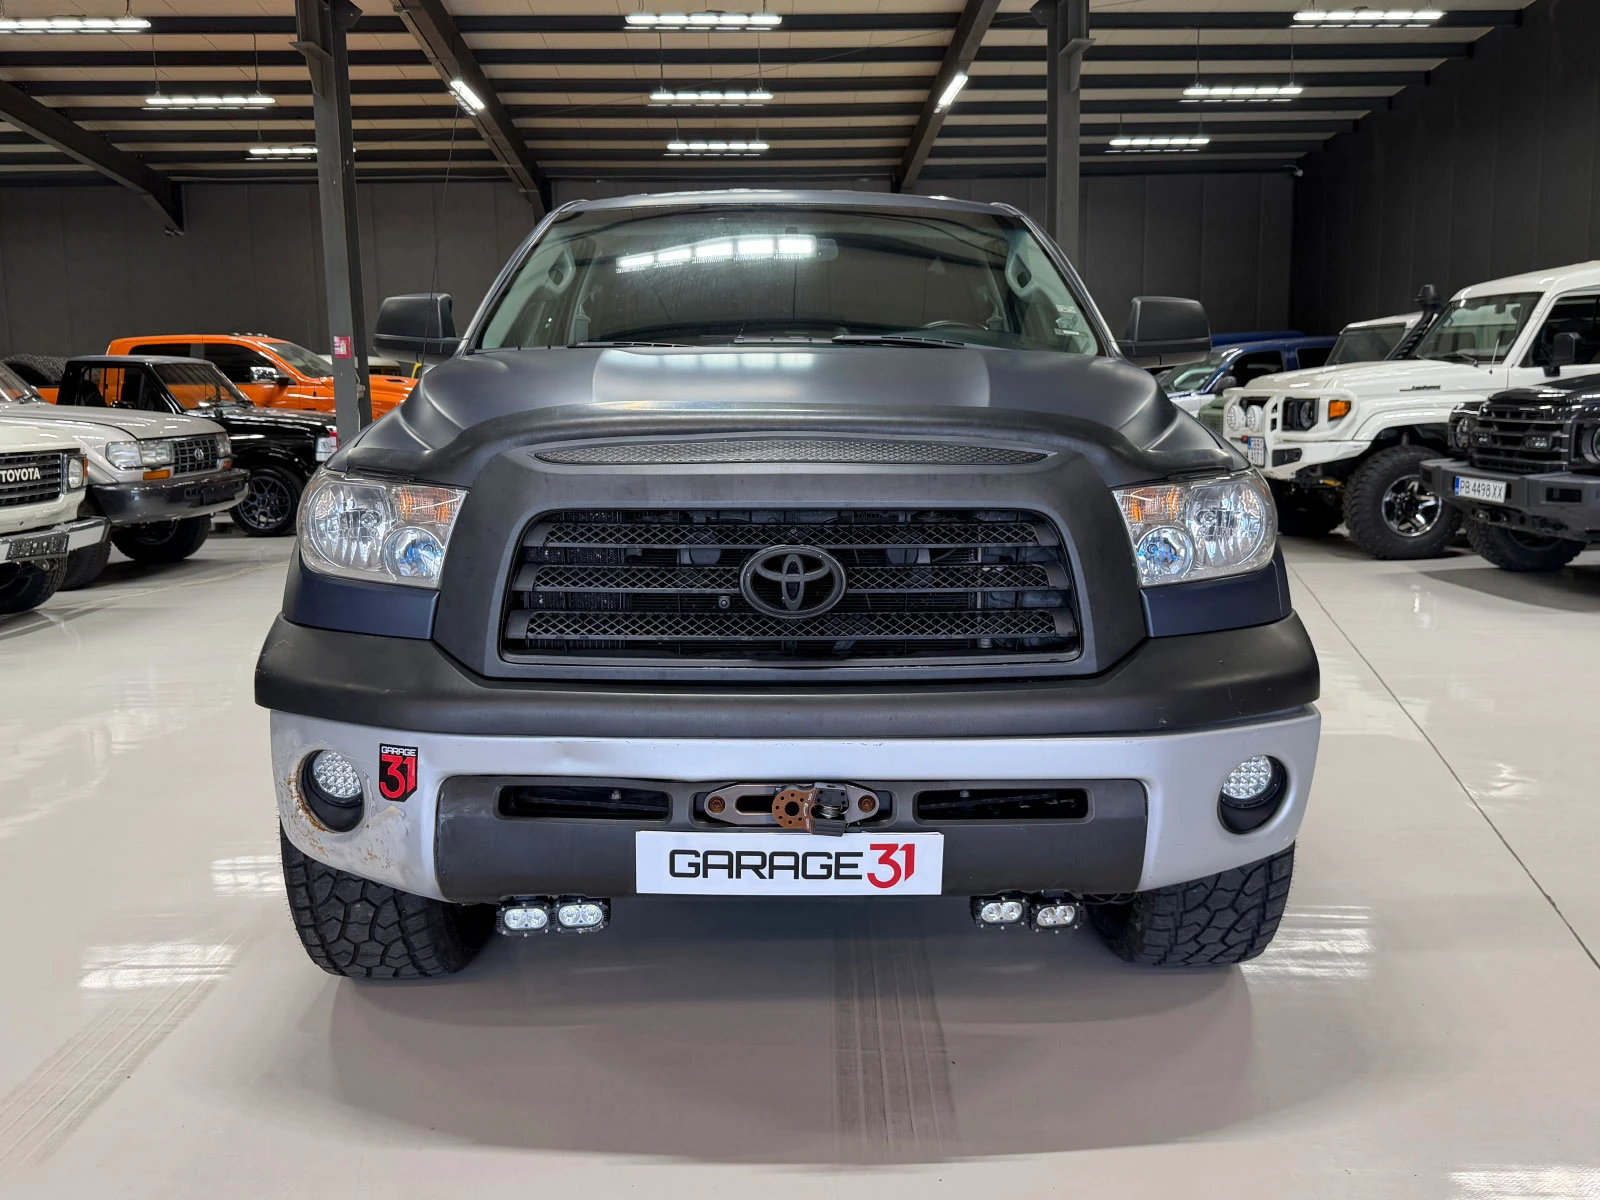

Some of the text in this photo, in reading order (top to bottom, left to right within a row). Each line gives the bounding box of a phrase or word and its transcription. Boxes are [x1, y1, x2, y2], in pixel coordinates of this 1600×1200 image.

[0, 467, 41, 483] TOYOTA
[1472, 482, 1491, 498] 4498
[381, 745, 417, 757] GARAGE
[380, 753, 416, 799] 31
